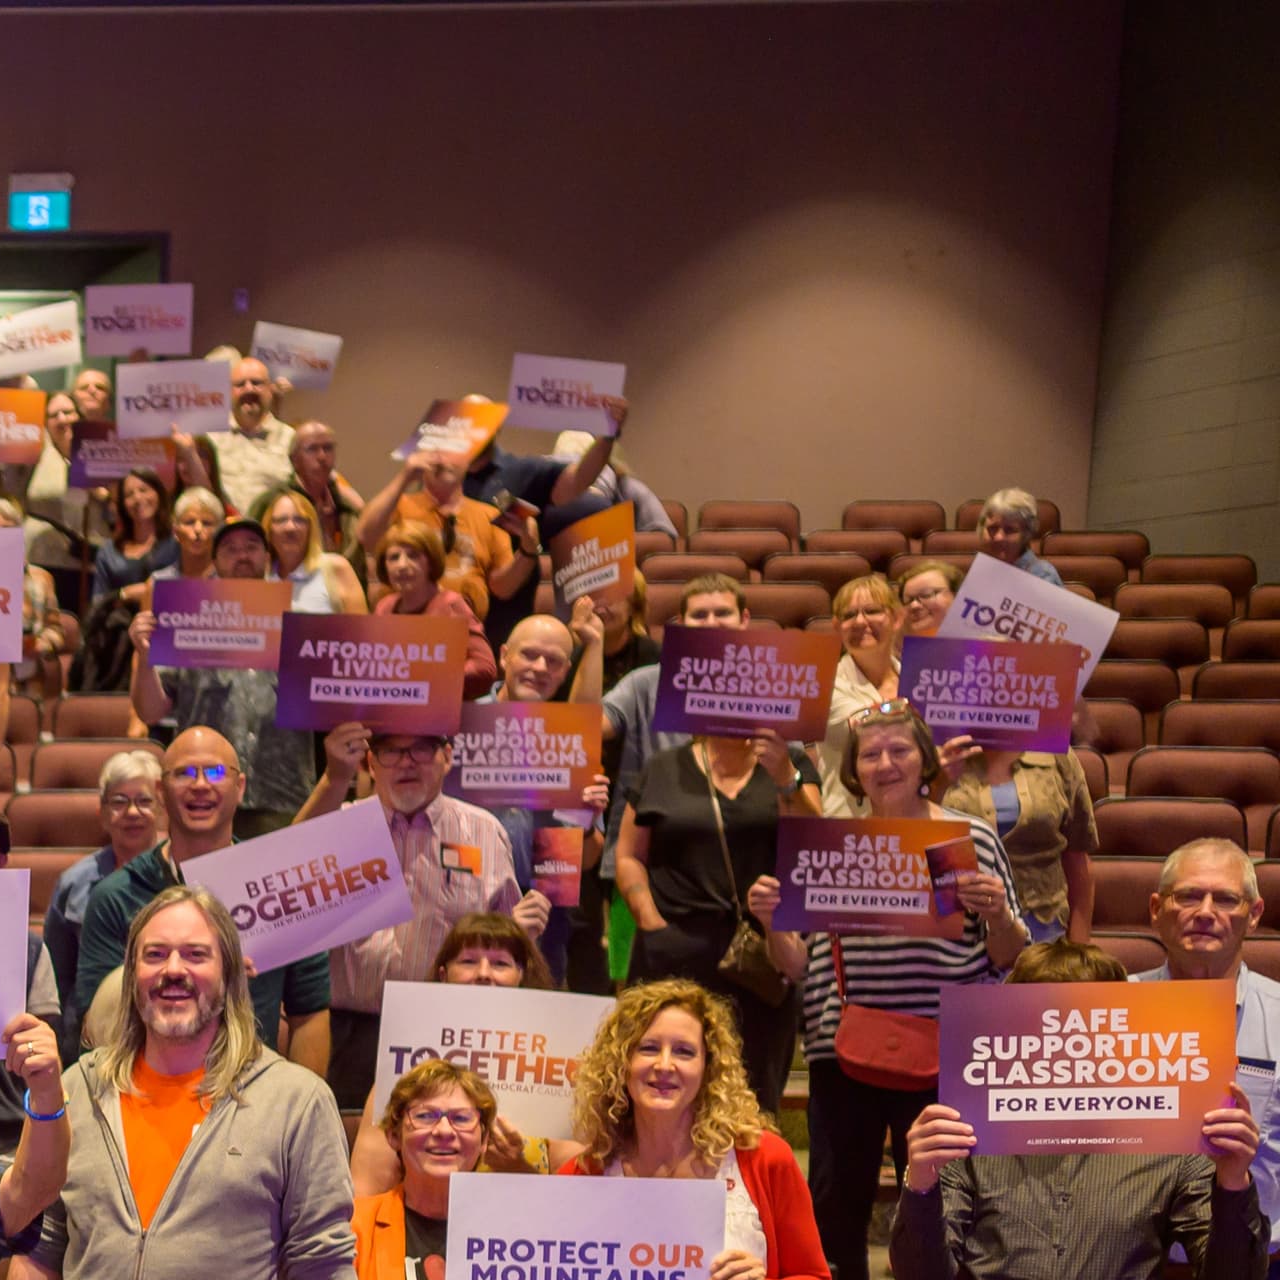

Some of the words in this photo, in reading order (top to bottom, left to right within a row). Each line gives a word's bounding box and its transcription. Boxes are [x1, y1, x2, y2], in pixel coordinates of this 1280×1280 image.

[200, 600, 241, 614] SAFE
[999, 596, 1069, 637] BETTER
[158, 611, 282, 629] COMMUNITIES
[299, 639, 447, 662] AFFORDABLE
[724, 642, 777, 664] SAFE
[332, 658, 410, 680] LIVING
[680, 656, 818, 682] SUPPORTIVE
[964, 653, 1017, 674] SAFE
[673, 672, 820, 698] CLASSROOMS
[918, 668, 1057, 690] SUPPORTIVE
[314, 684, 341, 697] FOR
[345, 684, 425, 700] EVERYONE.
[911, 684, 1060, 709] CLASSROOMS
[689, 696, 716, 710] FOR
[718, 699, 796, 717] EVERYONE.
[495, 716, 545, 735] SAFE
[929, 709, 956, 721] FOR
[959, 711, 1035, 727] EVERYONE.
[453, 732, 584, 751] SUPPORTIVE
[451, 748, 587, 767] CLASSROOMS
[465, 771, 491, 783] FOR
[493, 771, 567, 786] EVERYONE.
[843, 834, 901, 853] SAFE
[797, 850, 928, 871] SUPPORTIV
[245, 854, 340, 899] BETTER
[790, 868, 932, 889] CLASSROOM
[229, 857, 392, 931] OGETHER
[810, 894, 837, 905] FOR
[841, 894, 926, 910] EVERYONE.
[1041, 1008, 1129, 1034] SAFE
[441, 1027, 548, 1053] BETTER
[972, 1031, 1201, 1061] SUPPORTIVE
[962, 1057, 1211, 1086] CLASSROOMS
[995, 1096, 1039, 1113] FOR
[1044, 1094, 1174, 1113] EVERYONE.
[1077, 1137, 1115, 1145] DEMOCRAT
[466, 1237, 621, 1266] PROTECT
[629, 1244, 704, 1269] OUR
